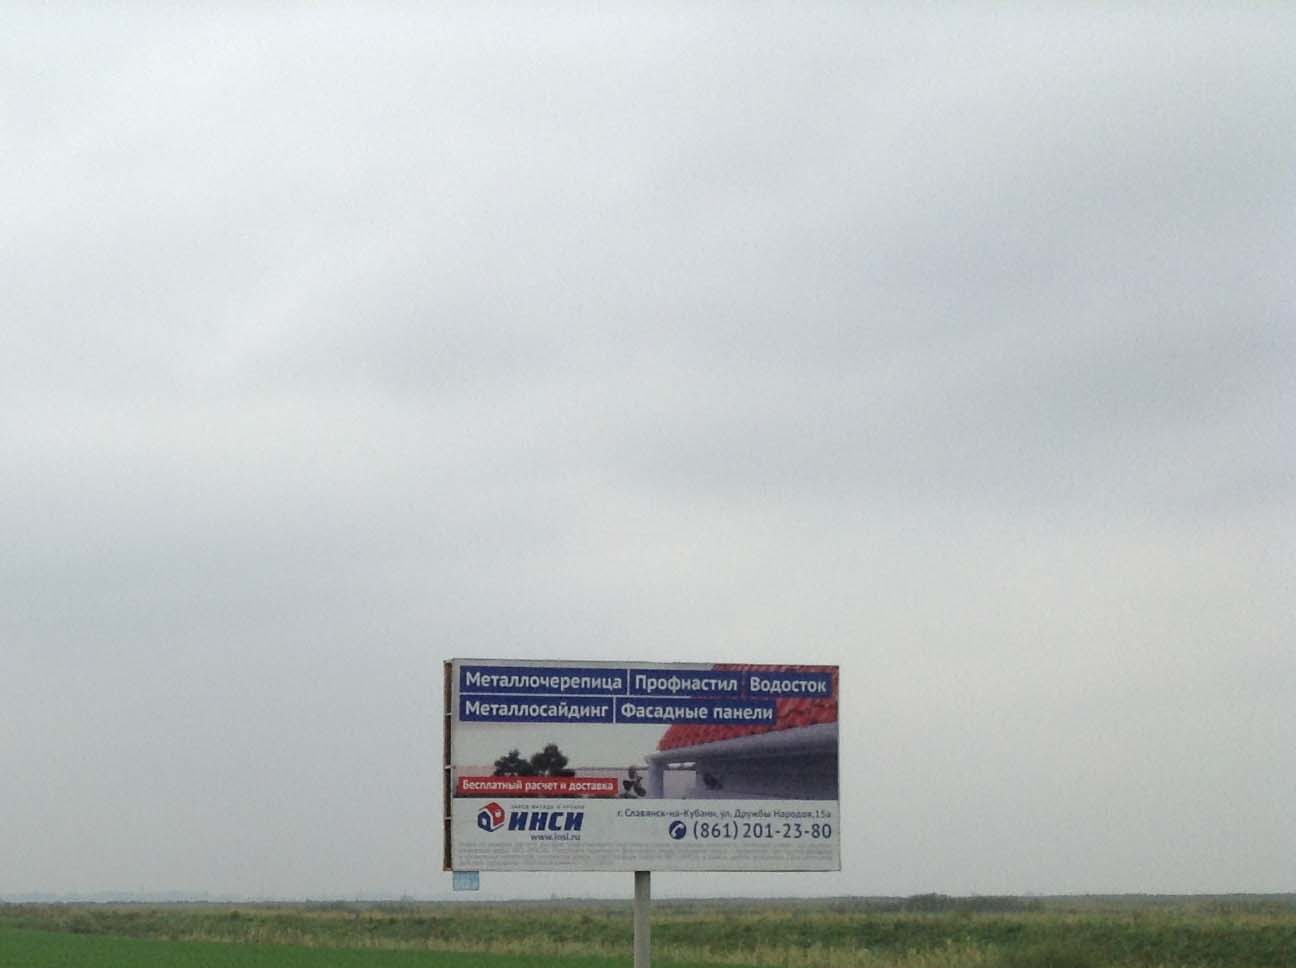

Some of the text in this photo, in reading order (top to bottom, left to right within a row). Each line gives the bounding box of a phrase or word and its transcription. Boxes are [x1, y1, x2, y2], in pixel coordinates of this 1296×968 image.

[465, 671, 827, 694] Металлочерепица Профнастил Водосток
[465, 700, 773, 720] Металлосайдинг Фасадные панели
[463, 779, 523, 790] Бесплатный
[525, 781, 557, 791] расчет
[568, 782, 614, 791] доставка
[508, 811, 584, 831] ИНСИ
